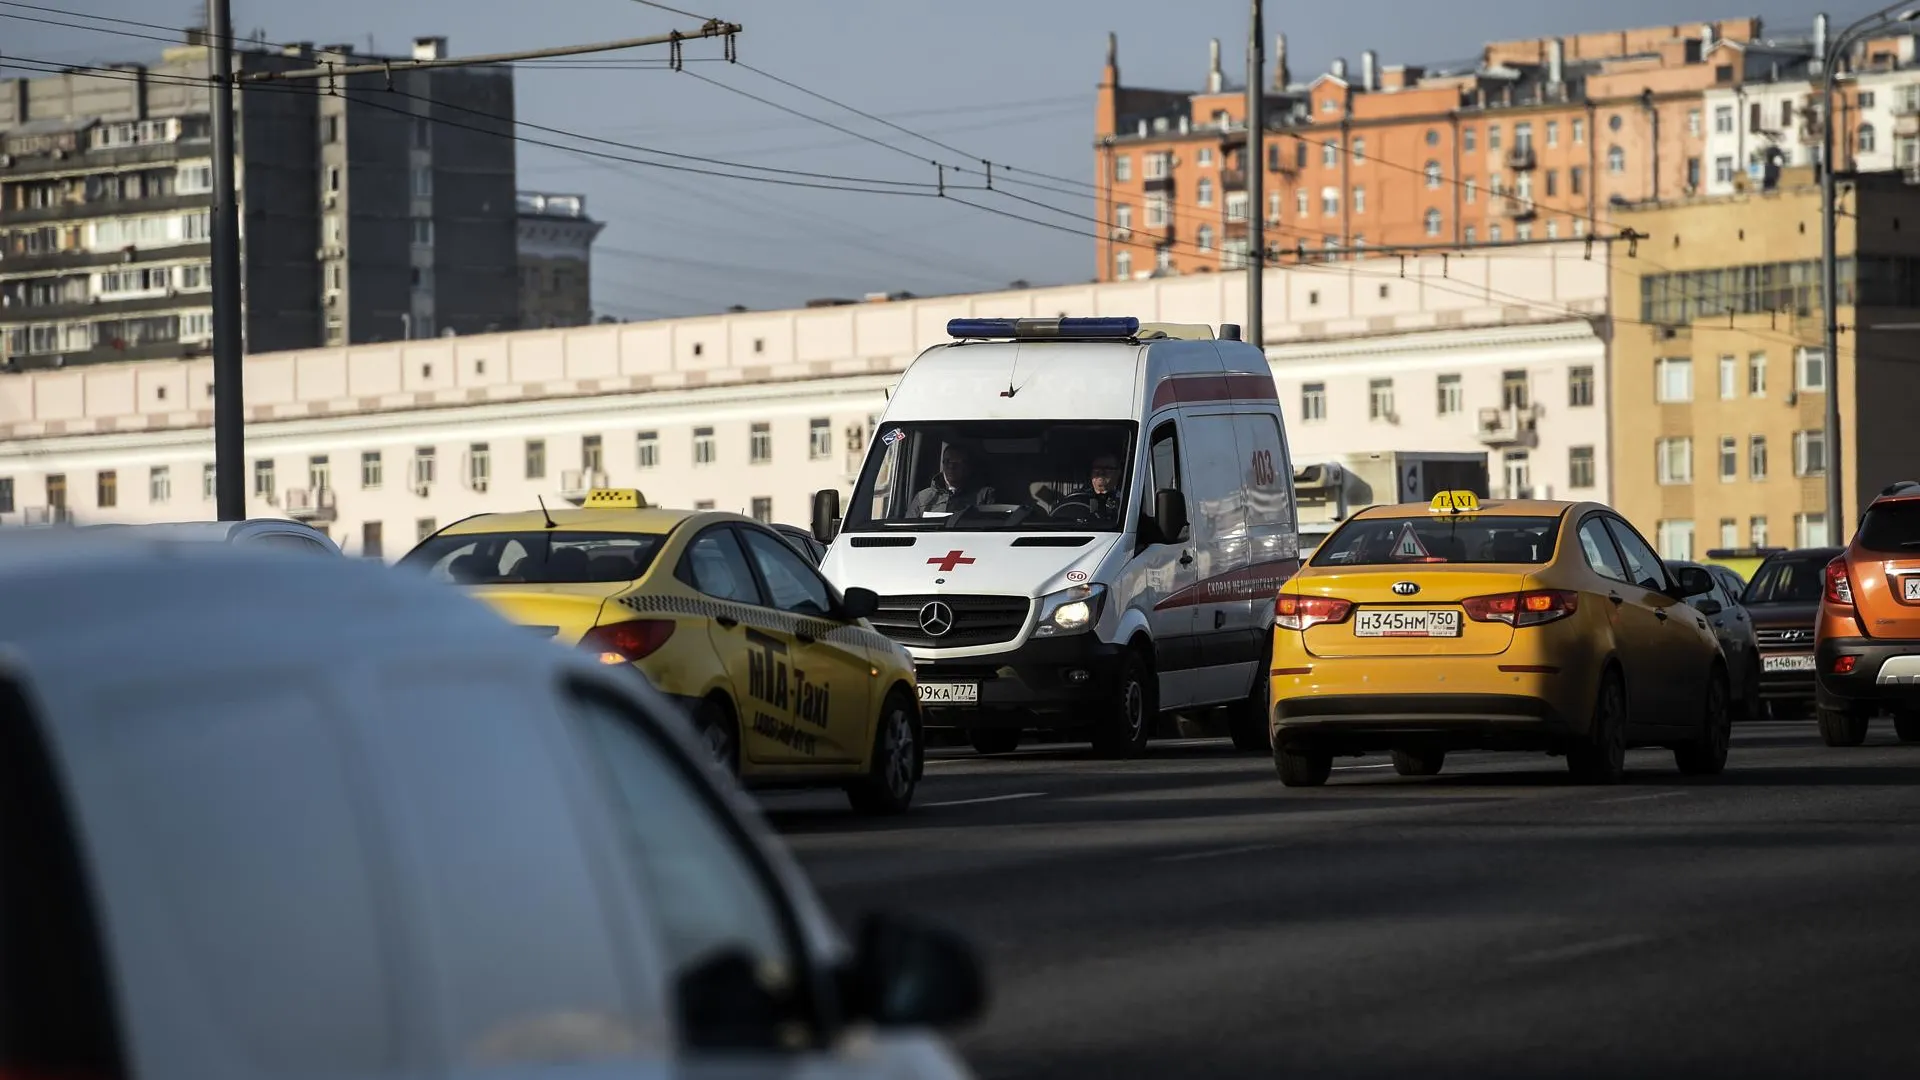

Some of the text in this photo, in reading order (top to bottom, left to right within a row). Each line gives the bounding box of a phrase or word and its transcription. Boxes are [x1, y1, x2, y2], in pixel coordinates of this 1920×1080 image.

[1251, 449, 1274, 486] 103
[1438, 495, 1472, 507] TAXI
[1396, 584, 1416, 593] KIA
[1361, 612, 1453, 630] Н345НМ 750
[953, 684, 973, 696] 777
